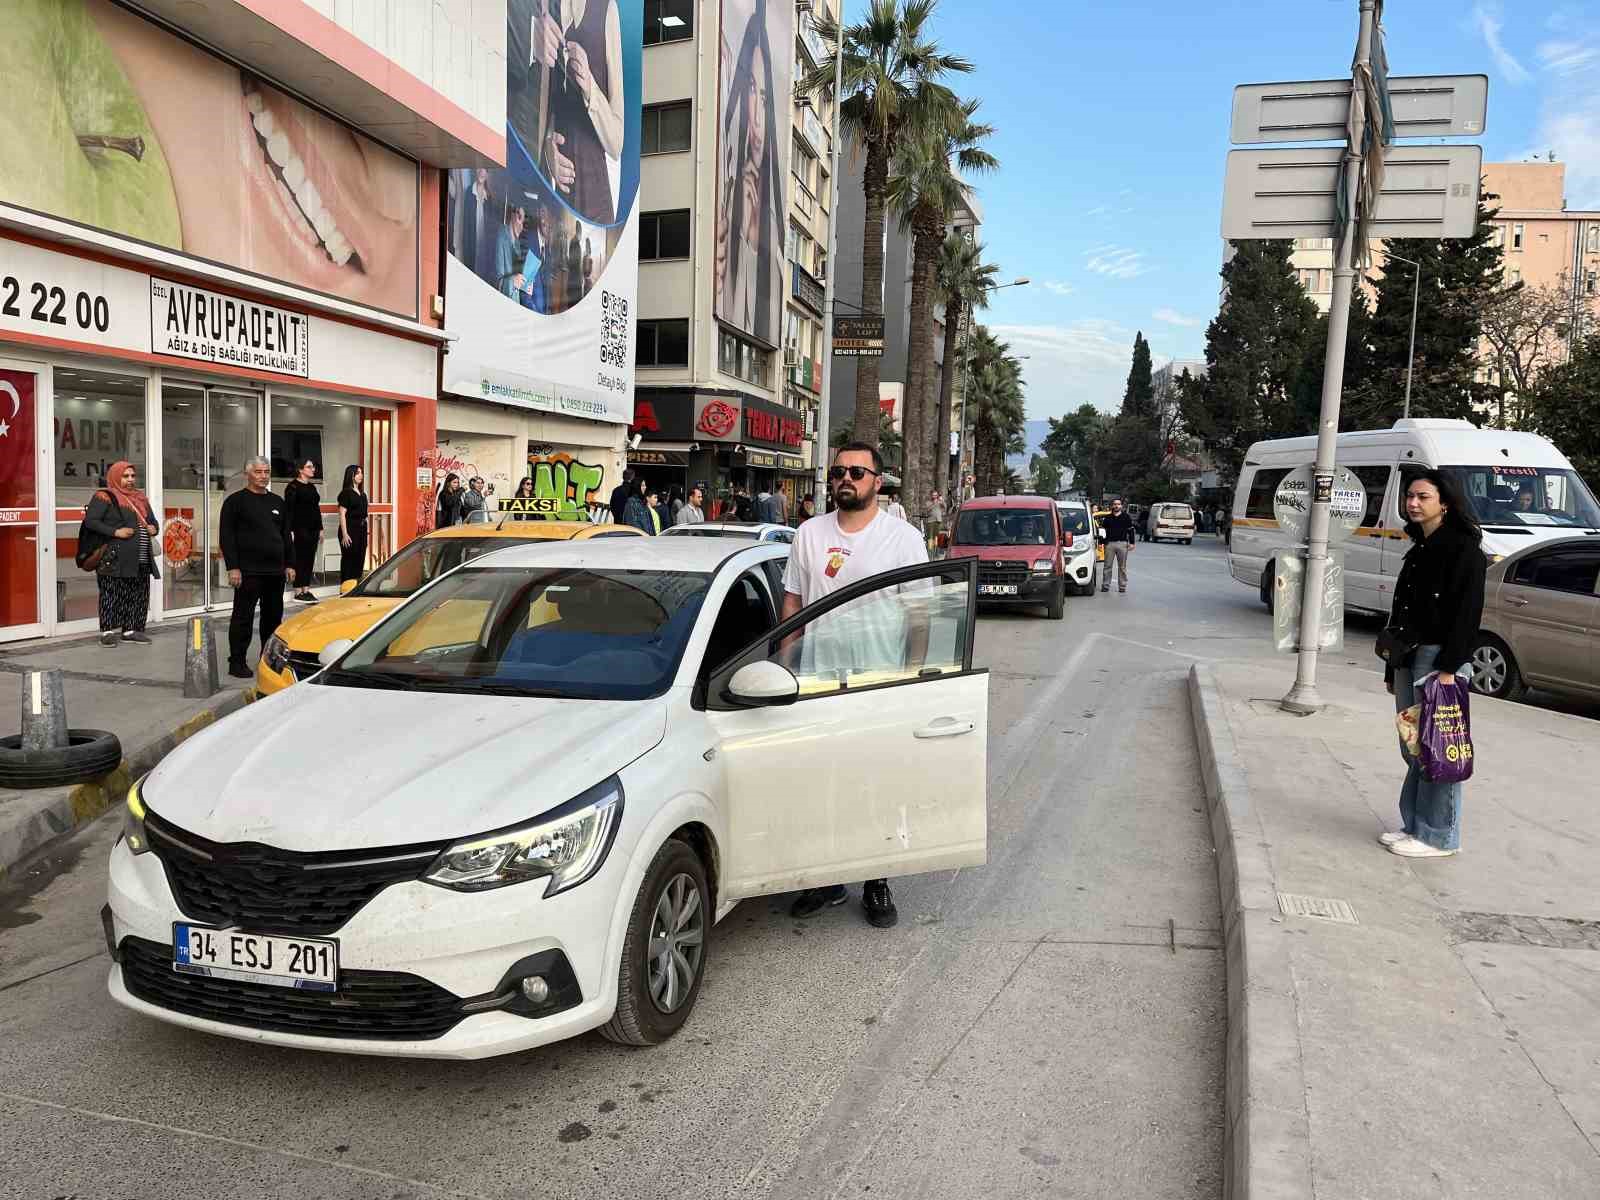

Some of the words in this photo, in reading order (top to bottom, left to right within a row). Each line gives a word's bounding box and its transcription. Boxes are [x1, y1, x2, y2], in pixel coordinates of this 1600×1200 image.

[30, 281, 67, 325] 22
[75, 291, 110, 333] 00
[153, 282, 168, 299] ÖZEL
[166, 286, 301, 356] AVRUPADENT
[167, 335, 190, 354] AĞIZ
[191, 343, 199, 355] &
[201, 342, 216, 360] DİŞ
[219, 346, 251, 364] SAĞLIĞI
[253, 352, 299, 372] POLİKLİNİĞİ
[836, 339, 865, 347] HOTEL
[179, 946, 188, 955] TR
[191, 932, 217, 962] 34
[230, 936, 273, 970] ESJ
[287, 943, 328, 977] 201
